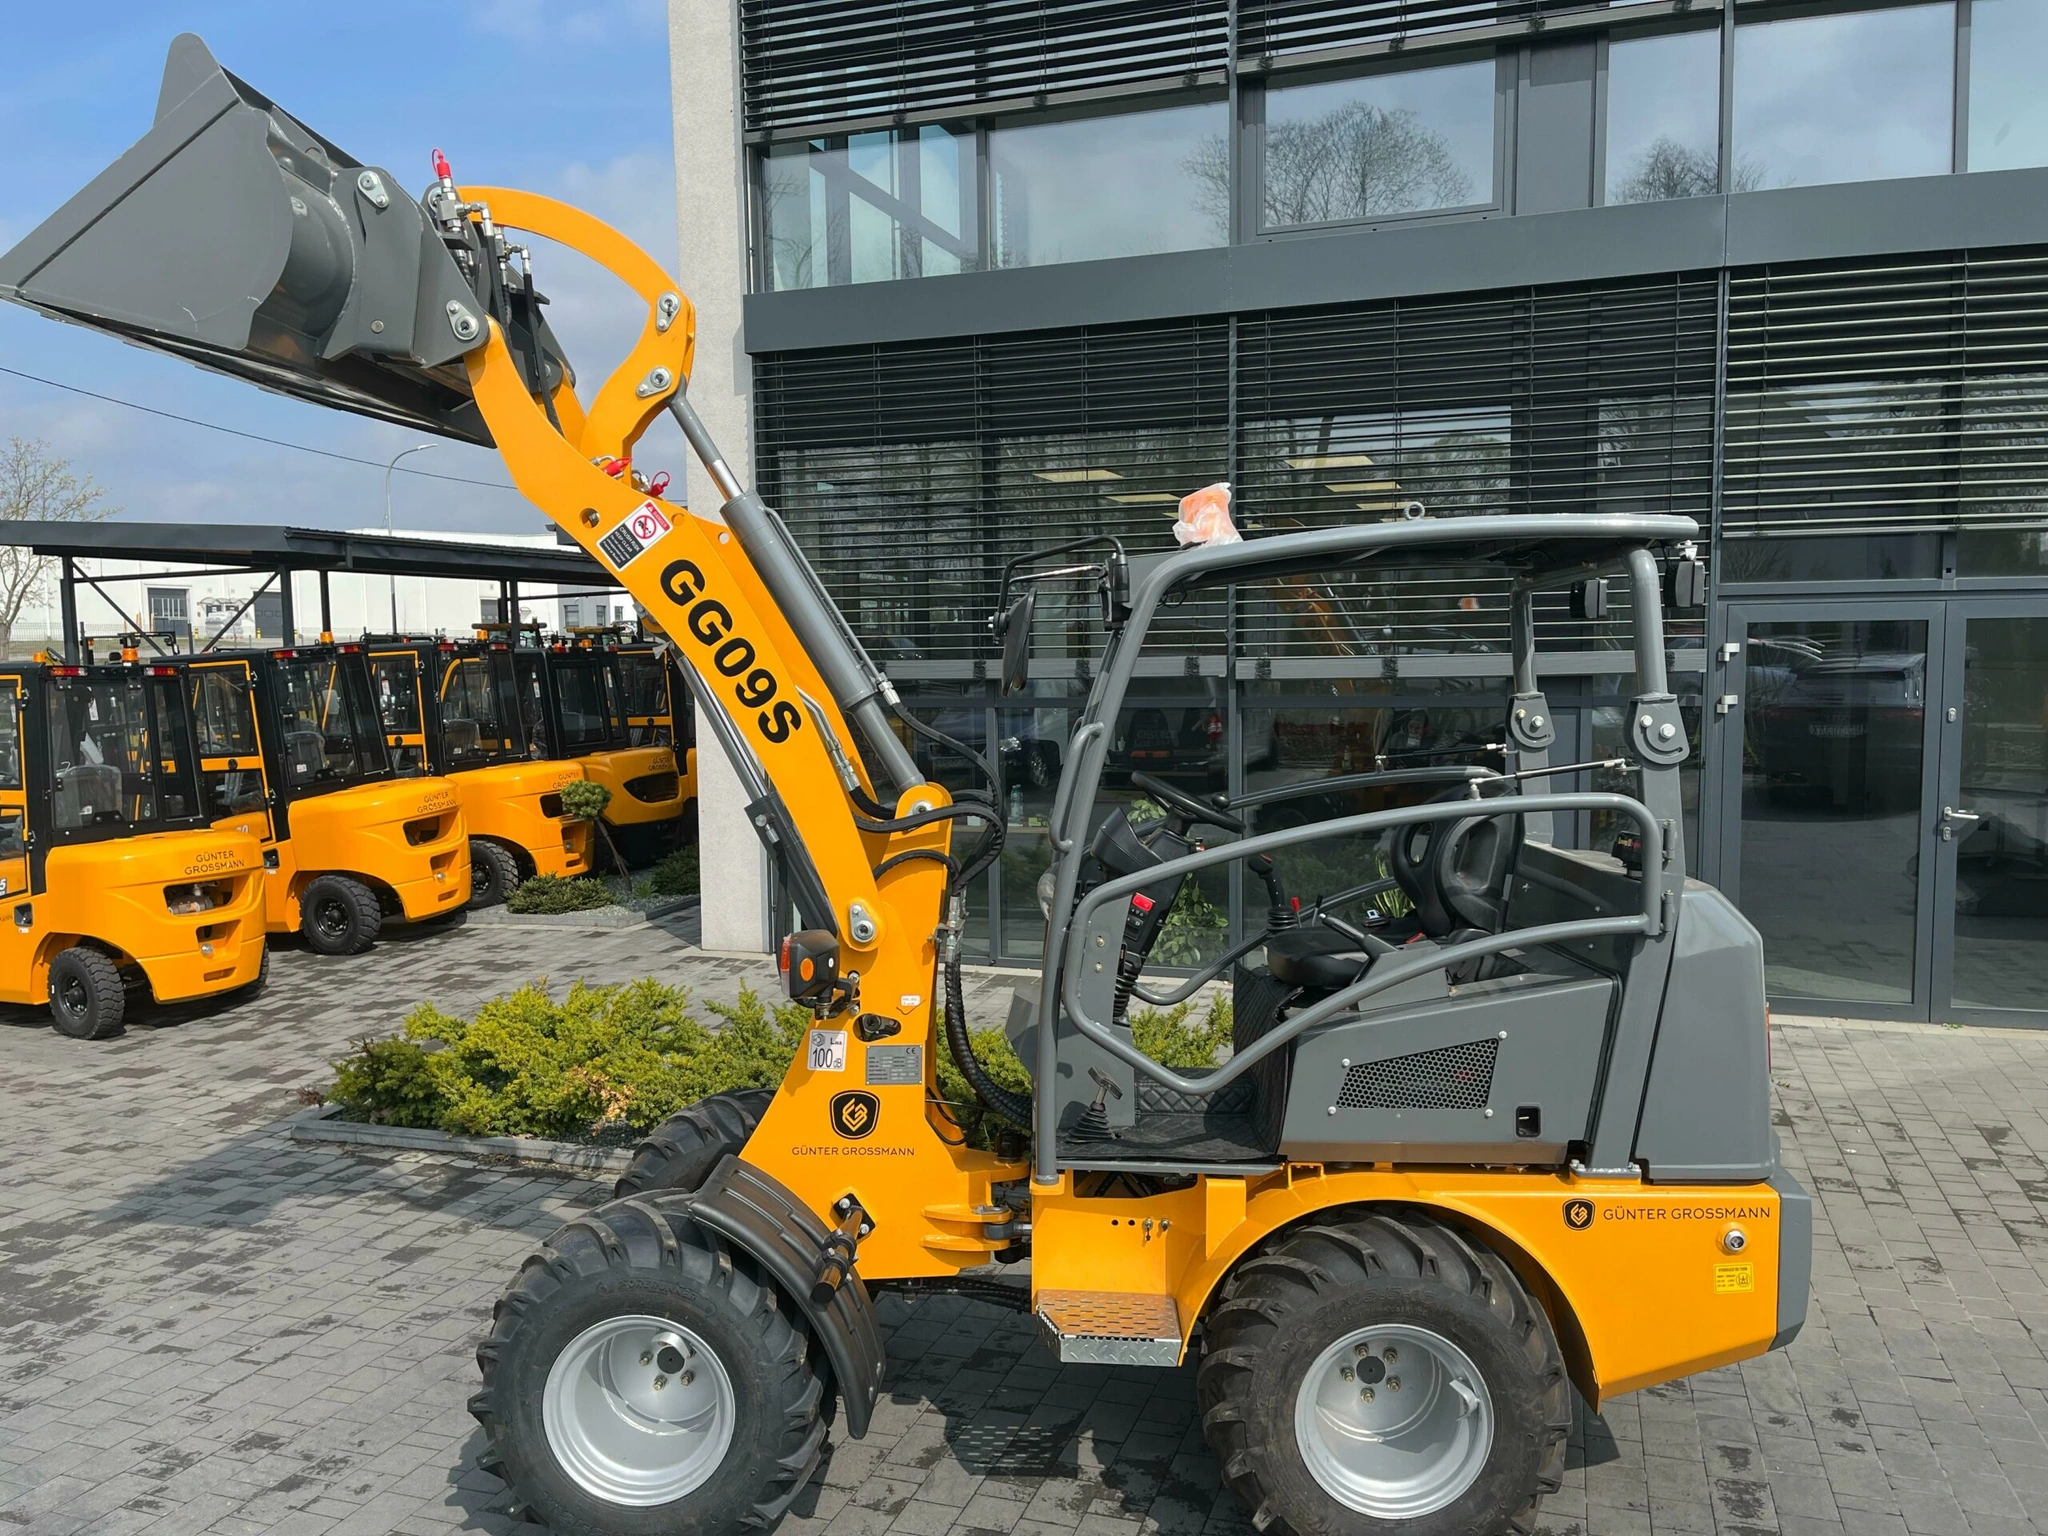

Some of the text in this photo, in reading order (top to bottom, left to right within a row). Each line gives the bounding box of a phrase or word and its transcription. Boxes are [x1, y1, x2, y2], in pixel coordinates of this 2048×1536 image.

[620, 527, 641, 552] CRUSH RISK
[660, 559, 802, 744] GG09S
[424, 791, 449, 803] GÜNTER
[196, 850, 235, 863] GÜNTER
[184, 860, 245, 875] GROSSMANN
[812, 1047, 843, 1069] 100 dB
[791, 1144, 915, 1156] GÜNTER GROSSMANN
[1603, 1205, 1771, 1220] GÜNTER GROSSMANN
